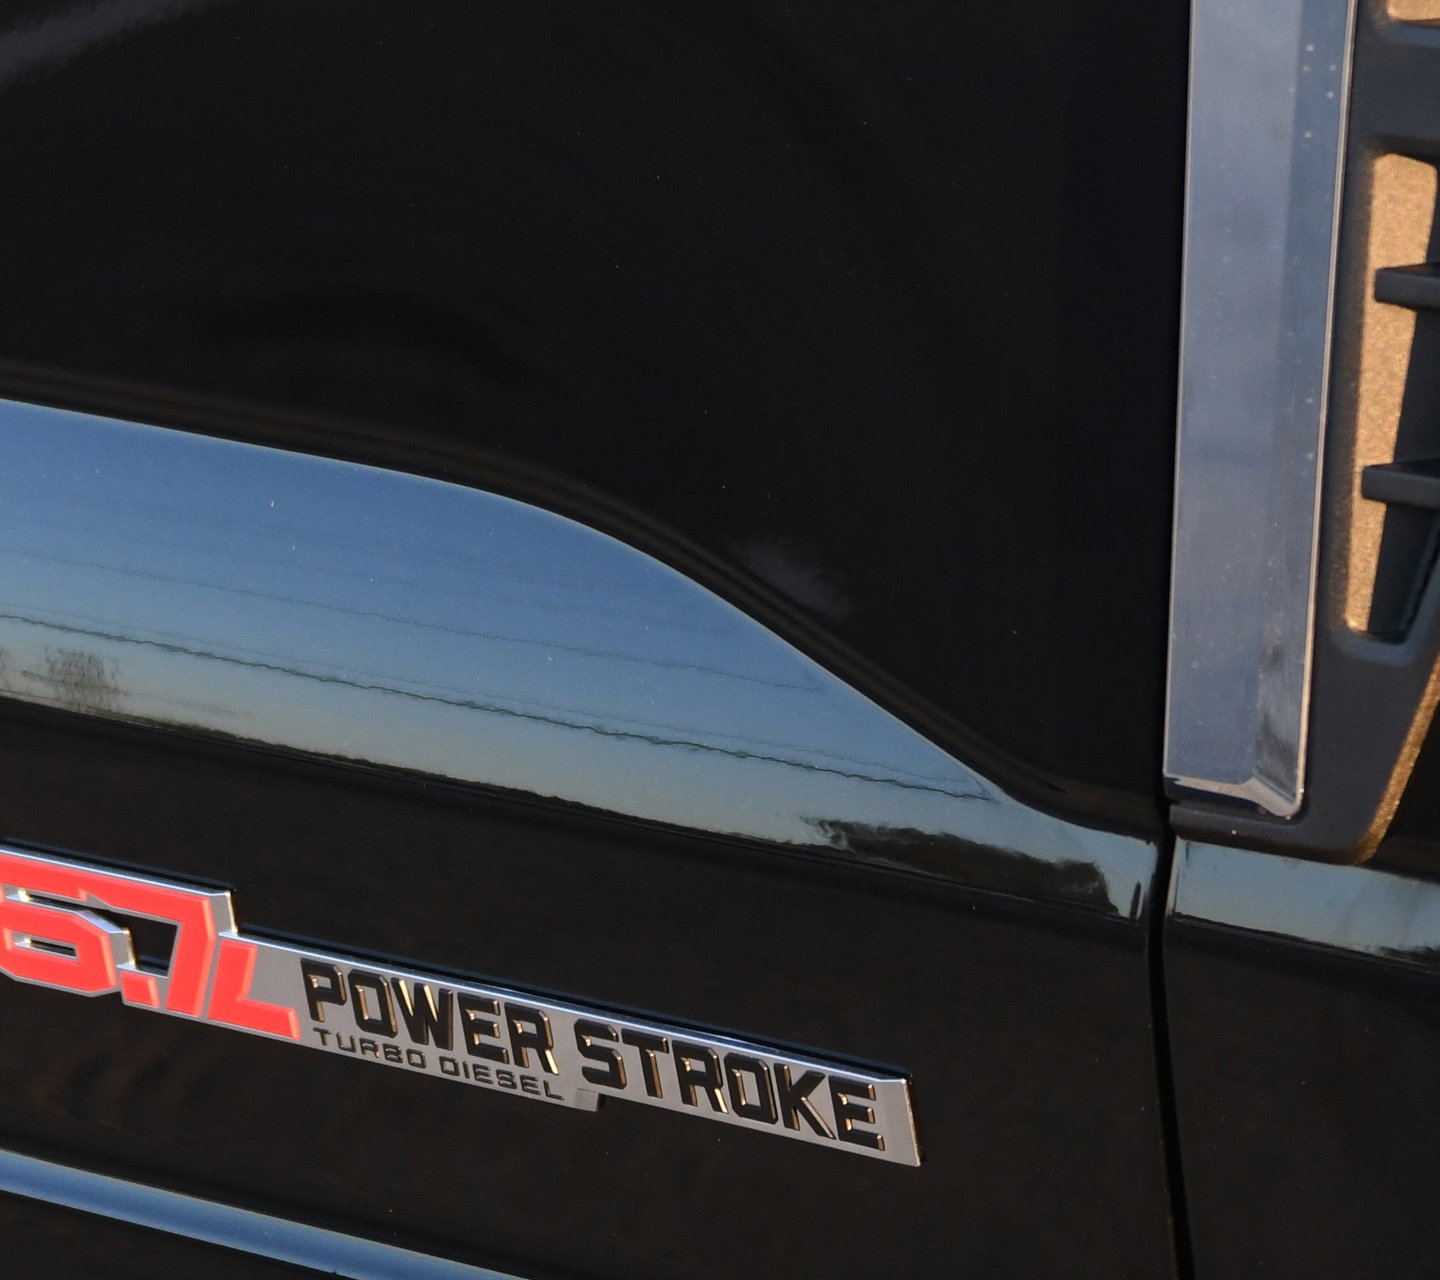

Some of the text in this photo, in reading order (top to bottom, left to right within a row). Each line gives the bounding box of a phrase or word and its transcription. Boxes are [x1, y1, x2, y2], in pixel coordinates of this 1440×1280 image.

[299, 957, 560, 1076] POWER
[573, 1018, 886, 1152] STROKE
[312, 1026, 566, 1102] TURBO DIESEL
